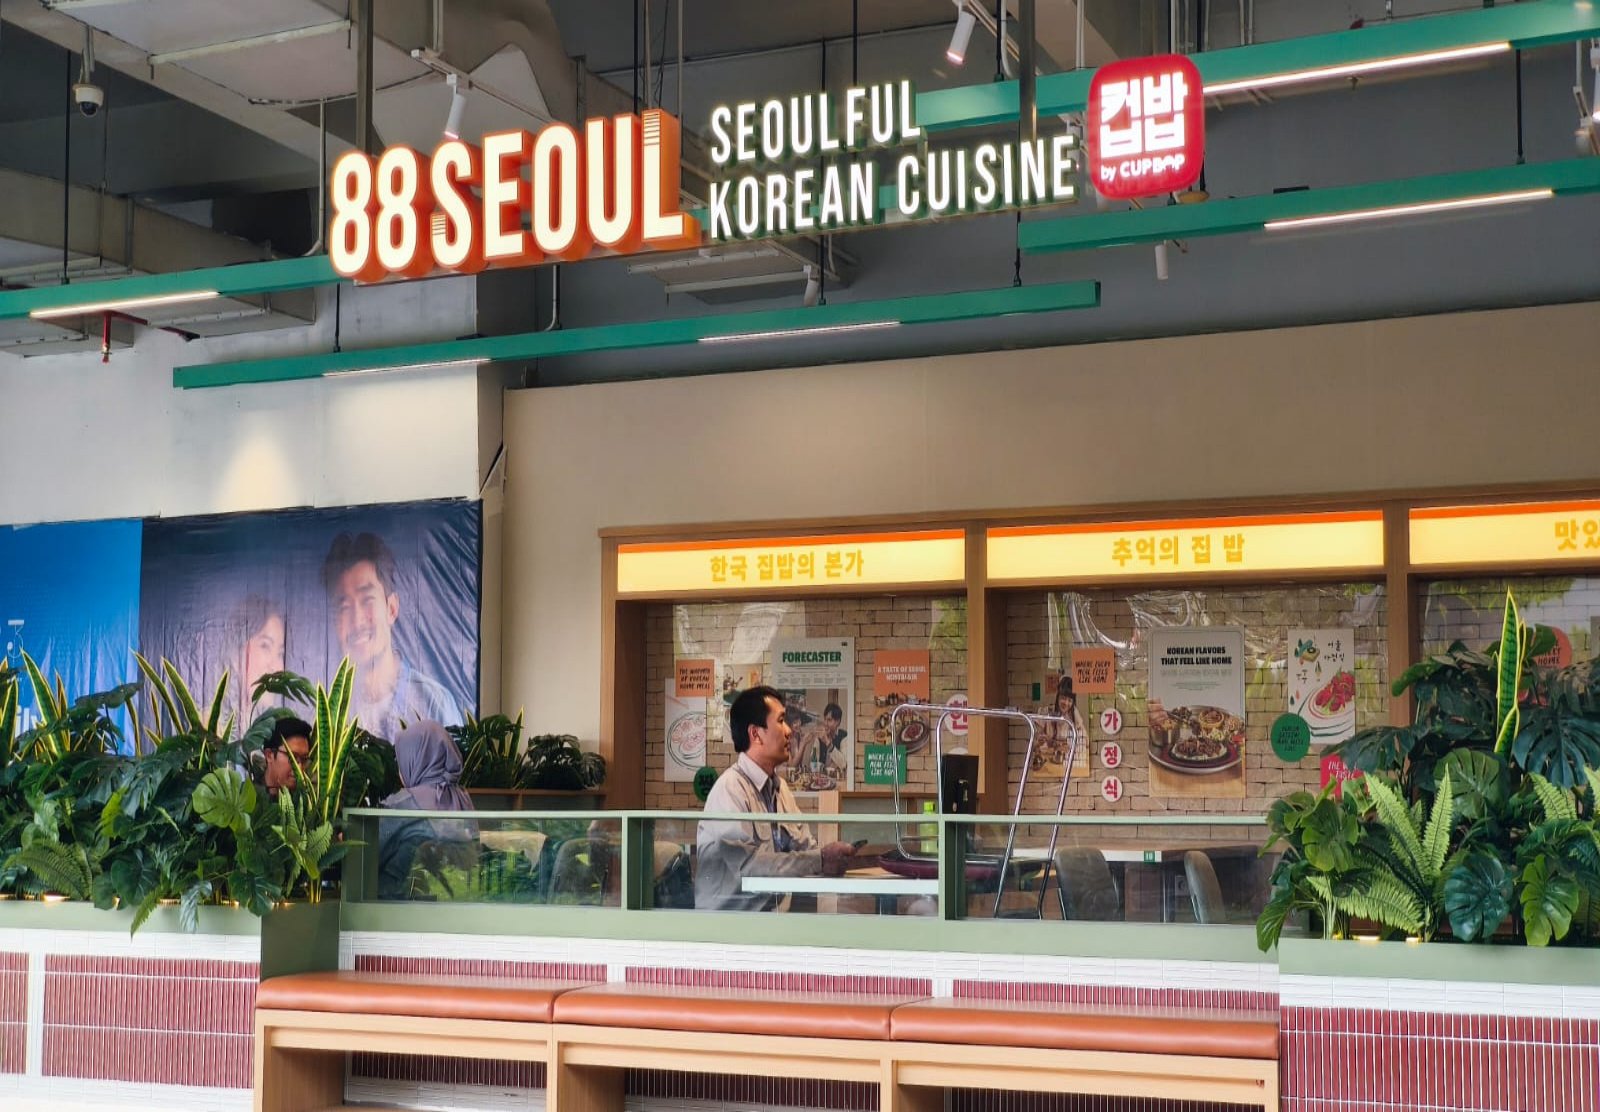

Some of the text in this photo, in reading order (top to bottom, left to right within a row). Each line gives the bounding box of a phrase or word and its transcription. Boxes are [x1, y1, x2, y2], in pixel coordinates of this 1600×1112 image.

[711, 79, 921, 164] SEOULFUL
[1101, 164, 1117, 182] by
[710, 134, 1076, 240] KOREAN CUISINE
[1112, 536, 1178, 567] 추억의
[710, 549, 864, 582] 한국 집밥의 본가
[782, 651, 841, 663] FORECASTER
[1161, 656, 1232, 666] THAT FEEL LIKE HOME
[1166, 646, 1226, 655] KOREAN FLAVORS
